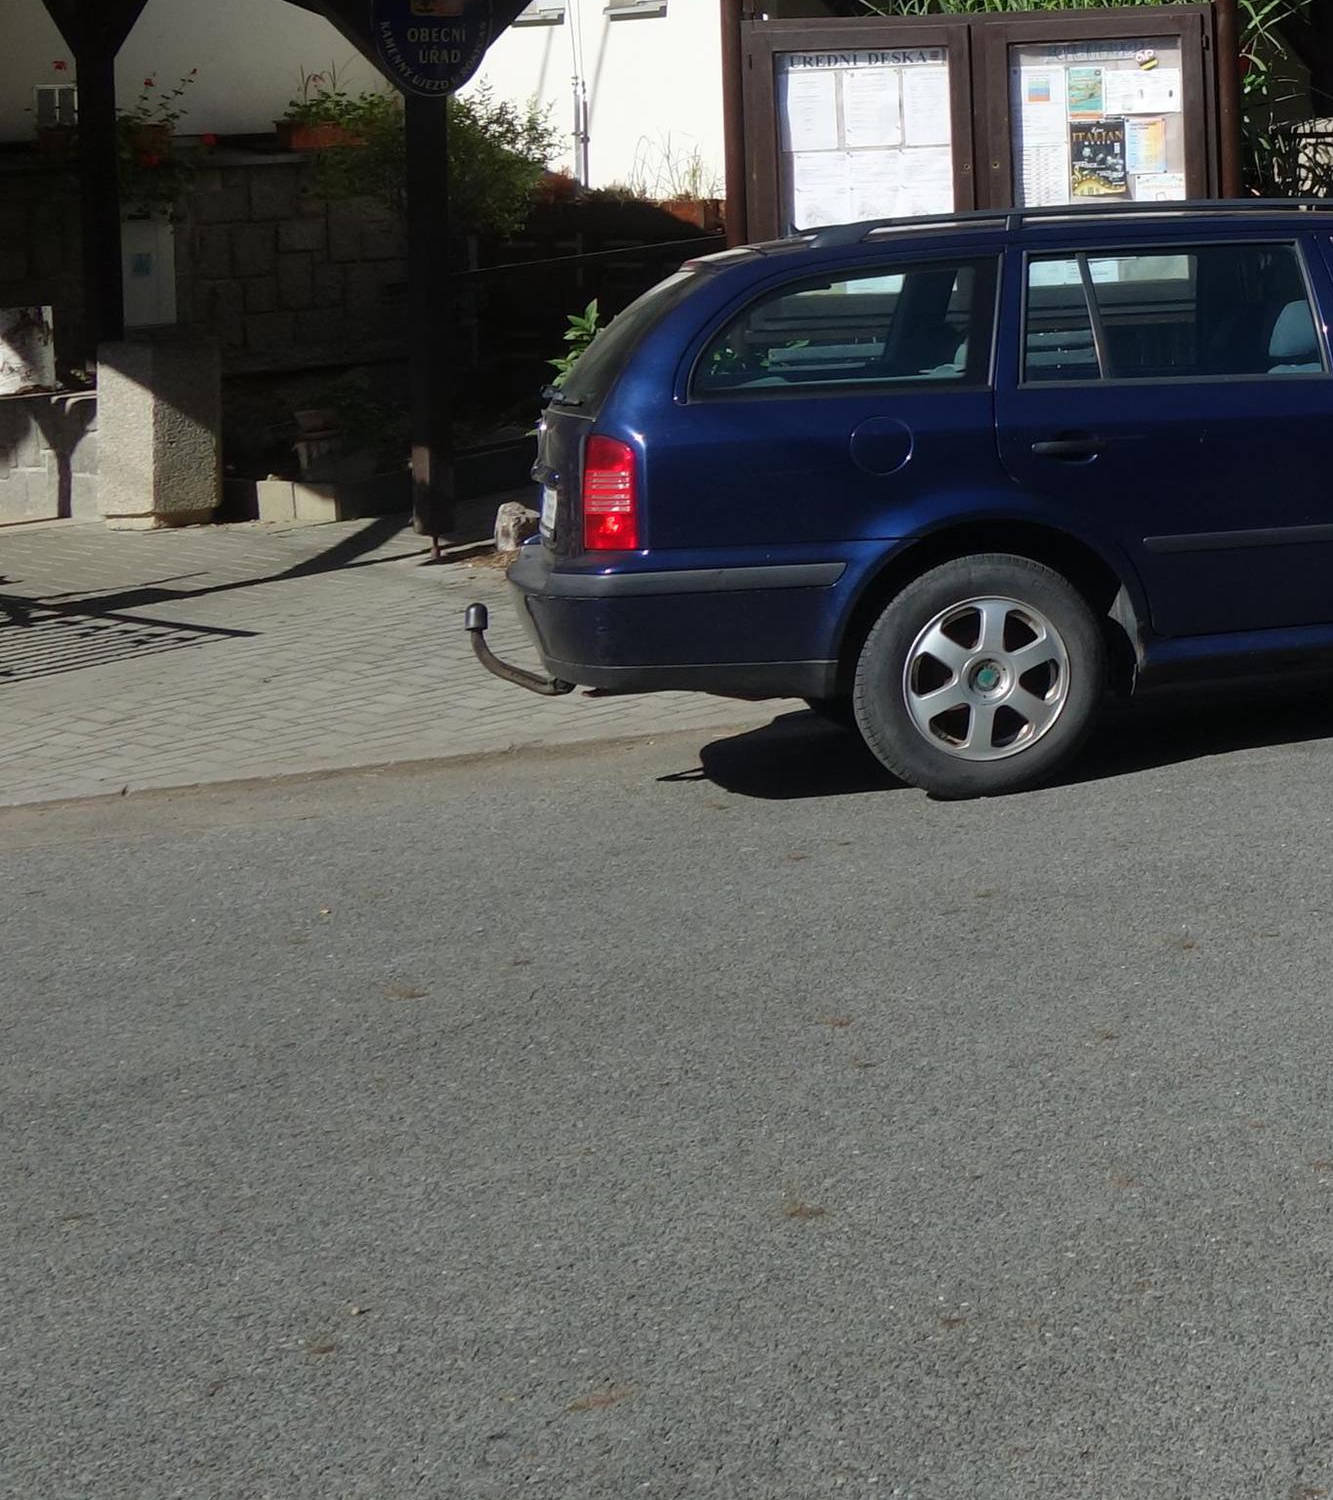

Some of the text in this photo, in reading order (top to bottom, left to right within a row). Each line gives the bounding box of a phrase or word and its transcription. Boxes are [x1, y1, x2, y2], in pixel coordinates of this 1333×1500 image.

[406, 23, 466, 43] OBECNÍ
[418, 44, 461, 64] ÚŘAD
[867, 50, 929, 66] DESKA
[1072, 130, 1125, 142] ITALIAN
